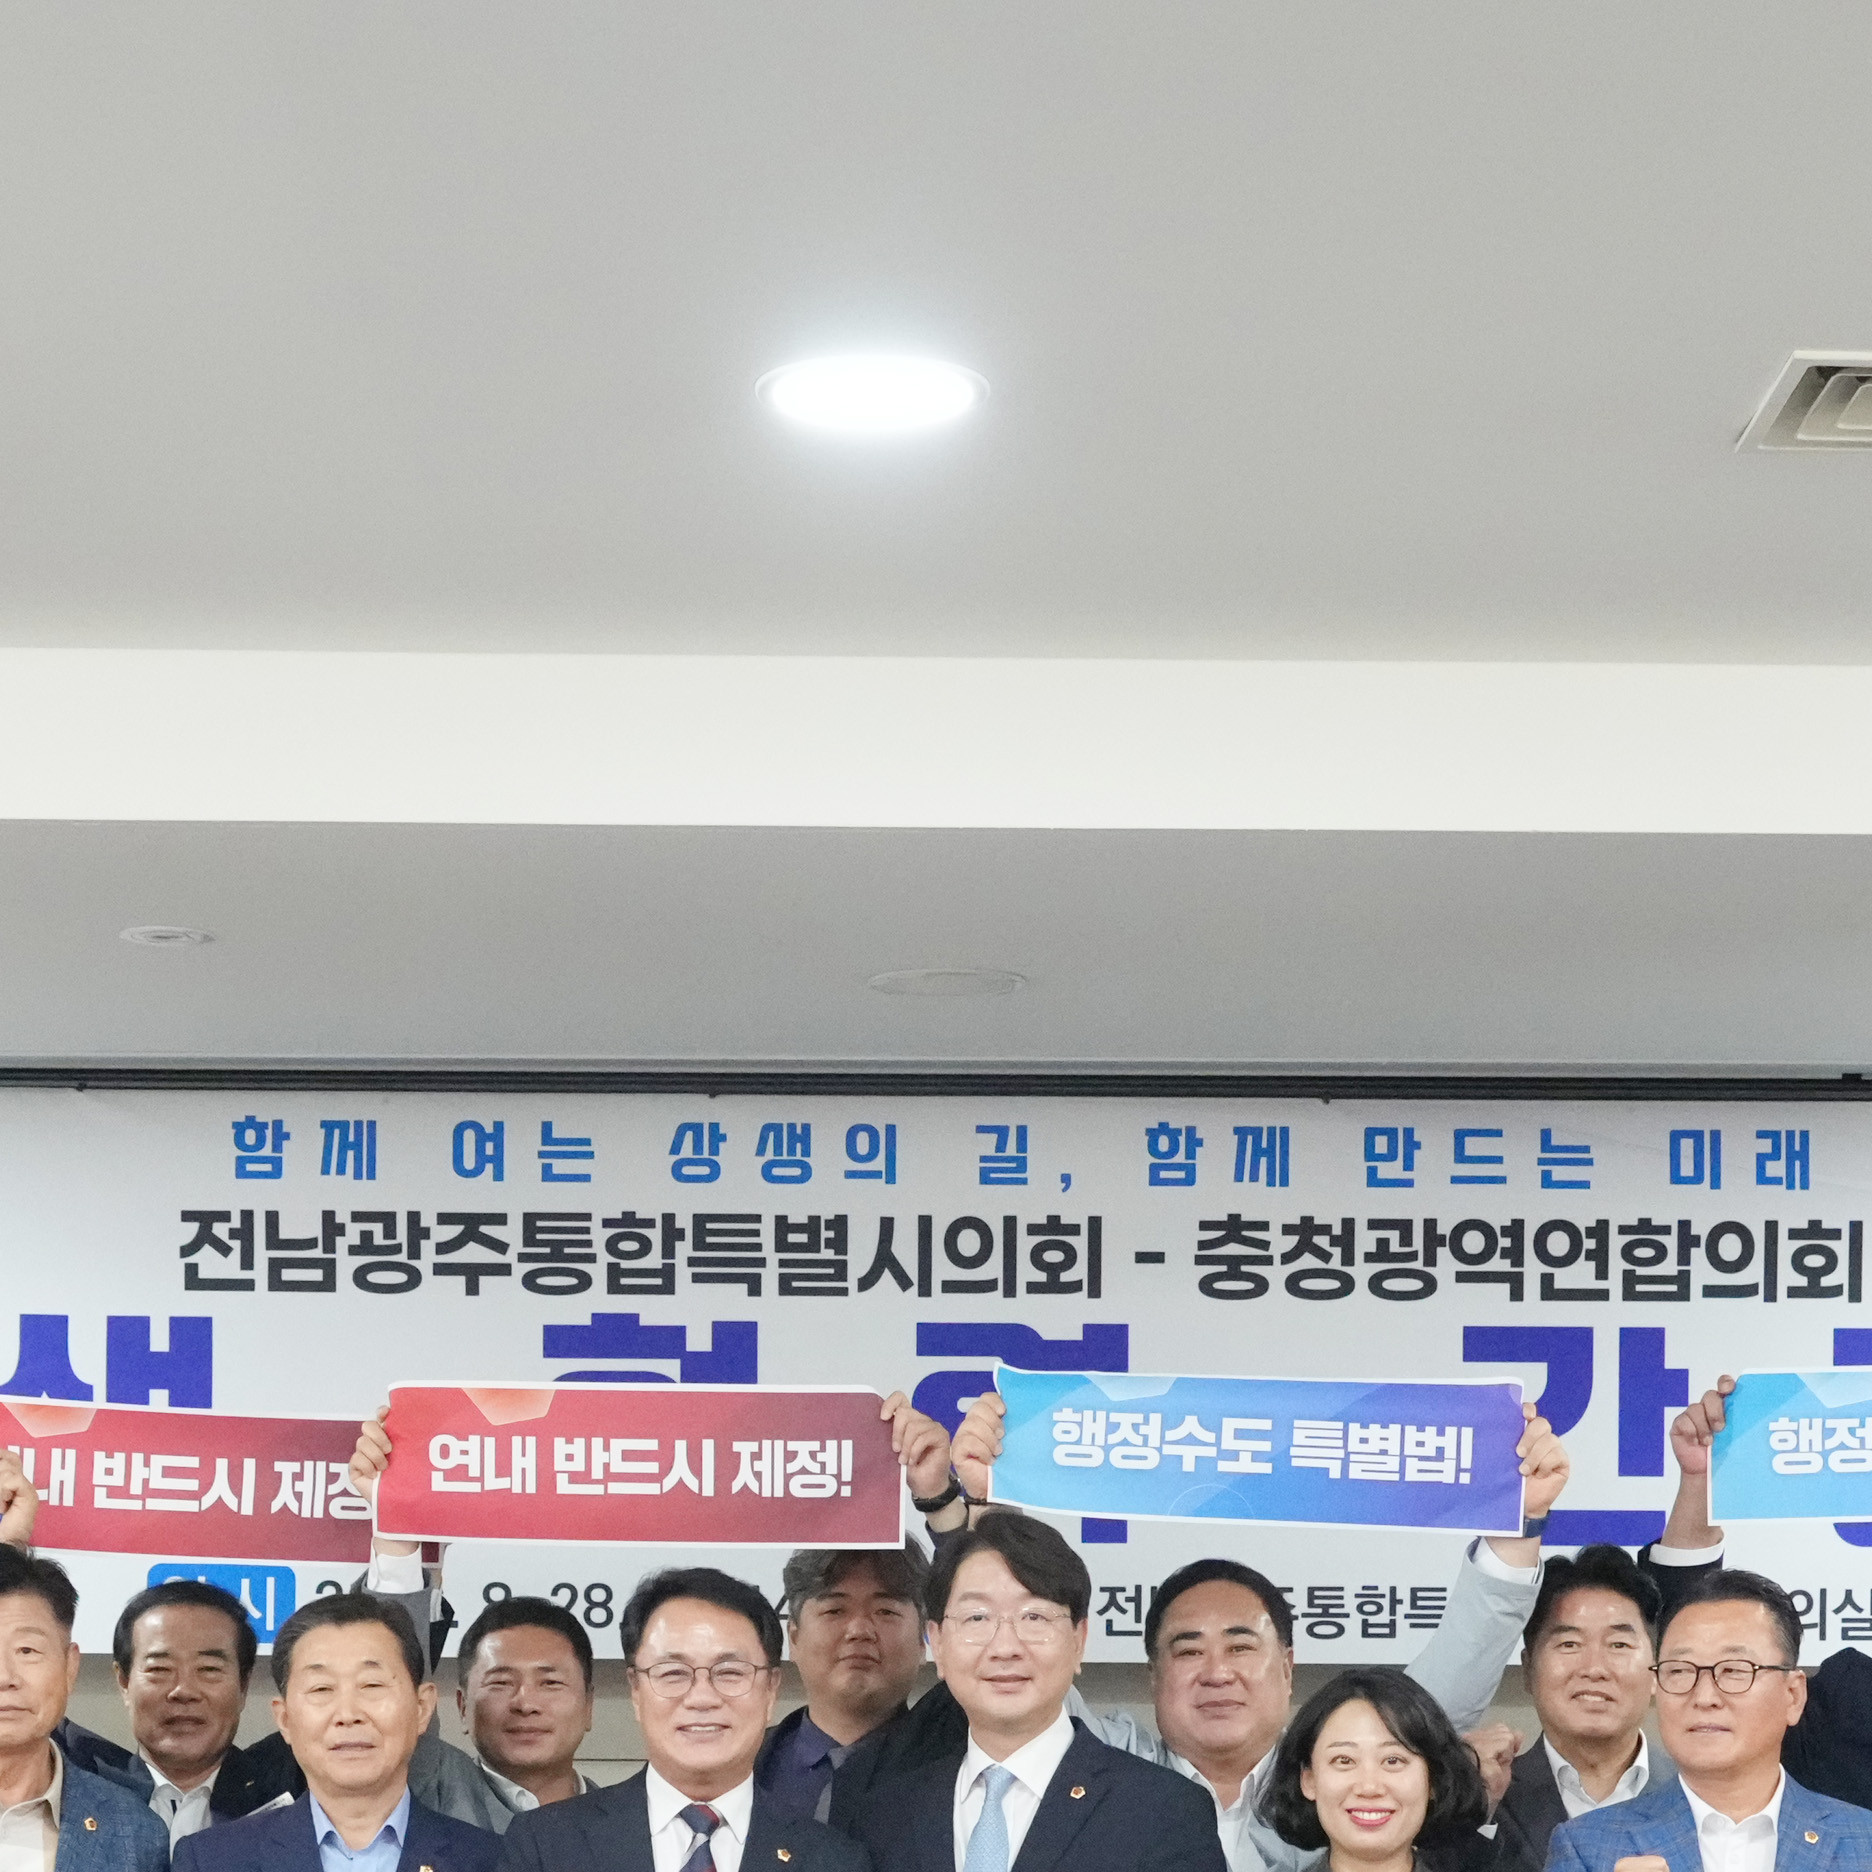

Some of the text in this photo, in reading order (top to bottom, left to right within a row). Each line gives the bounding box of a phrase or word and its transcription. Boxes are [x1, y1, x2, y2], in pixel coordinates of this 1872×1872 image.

[232, 1116, 1809, 1192] 함께 여는 상생의 길, 함께 만드는 미래
[180, 1210, 1102, 1298] 전남광주통합특별시의회
[1195, 1214, 1863, 1303] 충청광역연합의회
[429, 1434, 852, 1497] 연내 반드시 제정!
[1053, 1408, 1473, 1484] 행정수도 특별법!
[93, 1451, 255, 1515] 반드시
[270, 1460, 374, 1520] 제정
